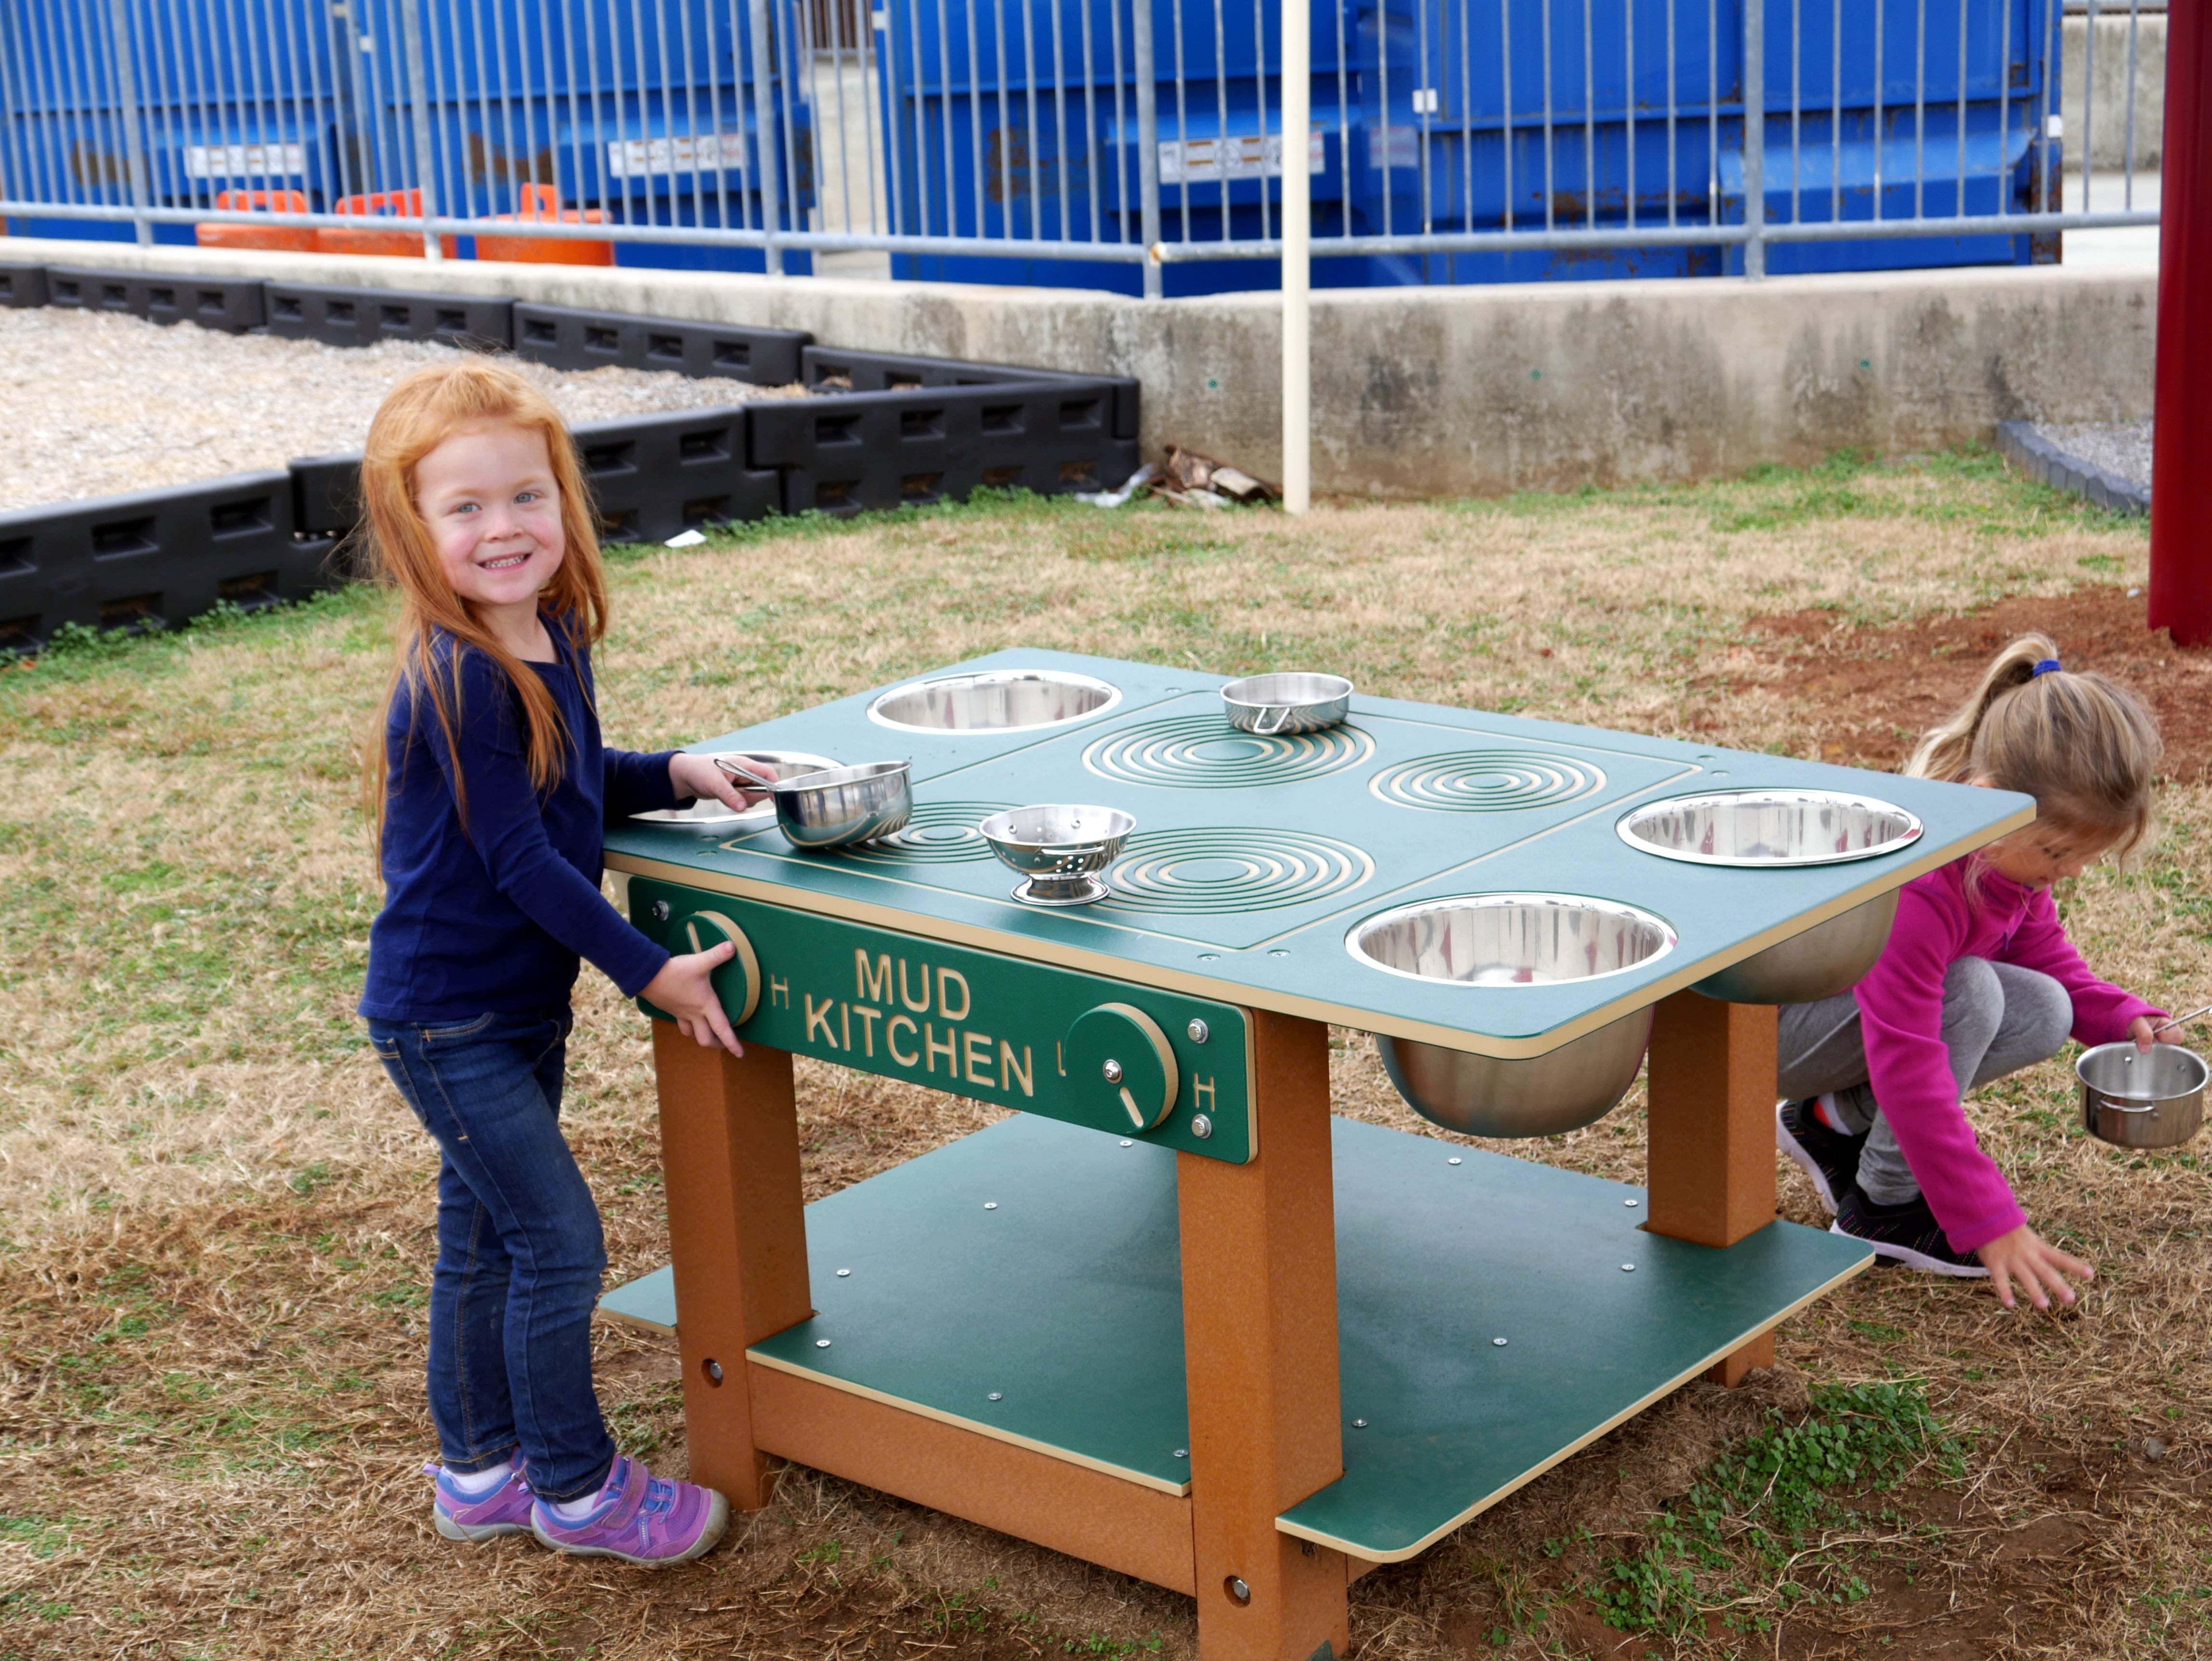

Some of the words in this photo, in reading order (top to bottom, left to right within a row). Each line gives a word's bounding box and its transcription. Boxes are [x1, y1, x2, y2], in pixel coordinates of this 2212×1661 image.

[770, 974, 789, 1009] H
[855, 948, 970, 1020] MUD
[804, 993, 1033, 1096] KITCHEN
[1193, 1072, 1215, 1112] H
